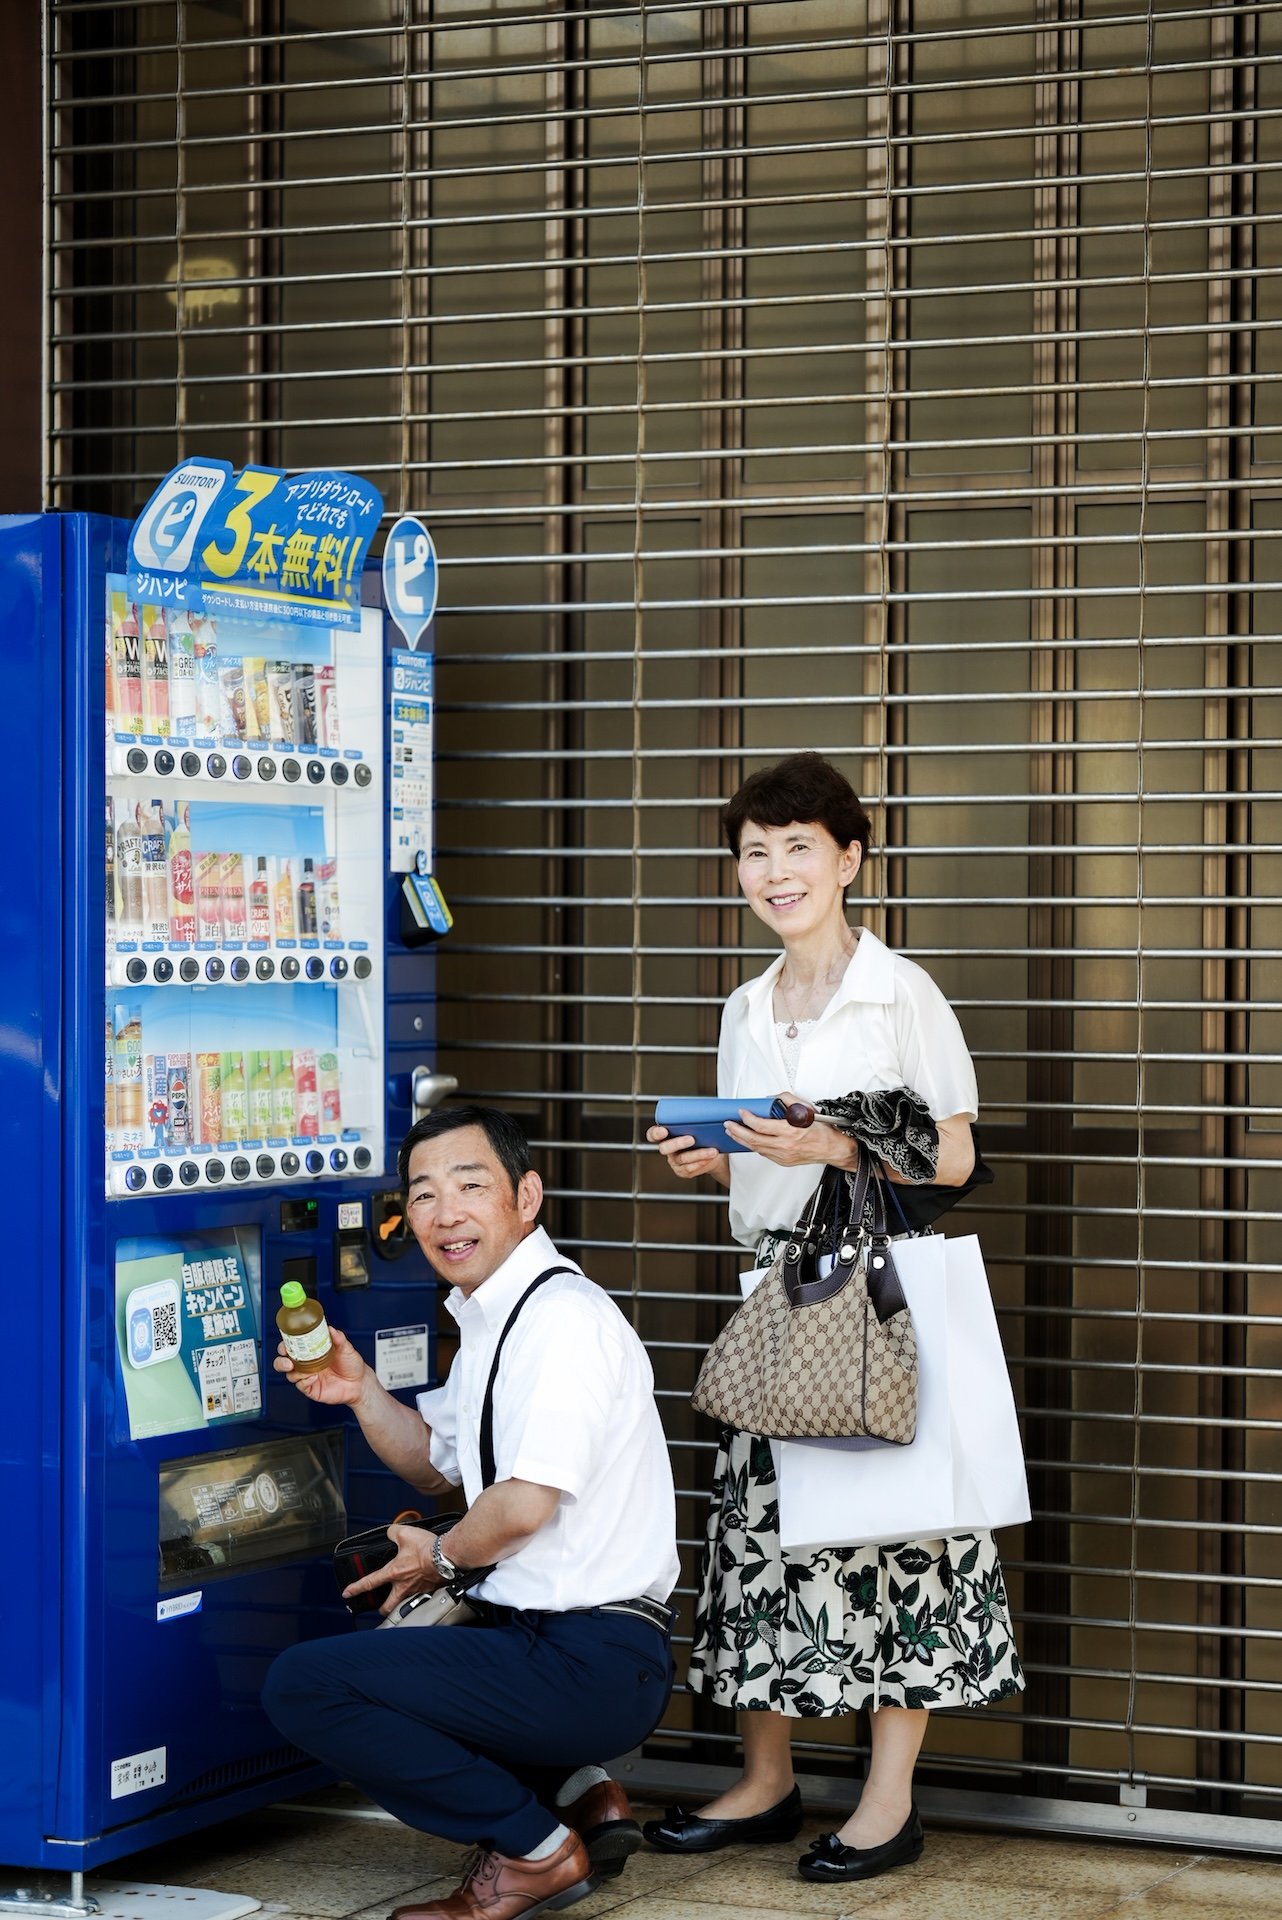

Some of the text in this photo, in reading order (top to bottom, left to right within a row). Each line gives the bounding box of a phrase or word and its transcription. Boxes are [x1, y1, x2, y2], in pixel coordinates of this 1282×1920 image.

[174, 473, 220, 489] SUNTORY
[284, 480, 375, 516] アプリダウンロード
[297, 502, 348, 529] でどれでも
[136, 573, 188, 601] ジハンピ
[181, 1257, 240, 1288] 自販機限定
[186, 1285, 244, 1314] キャンペーン
